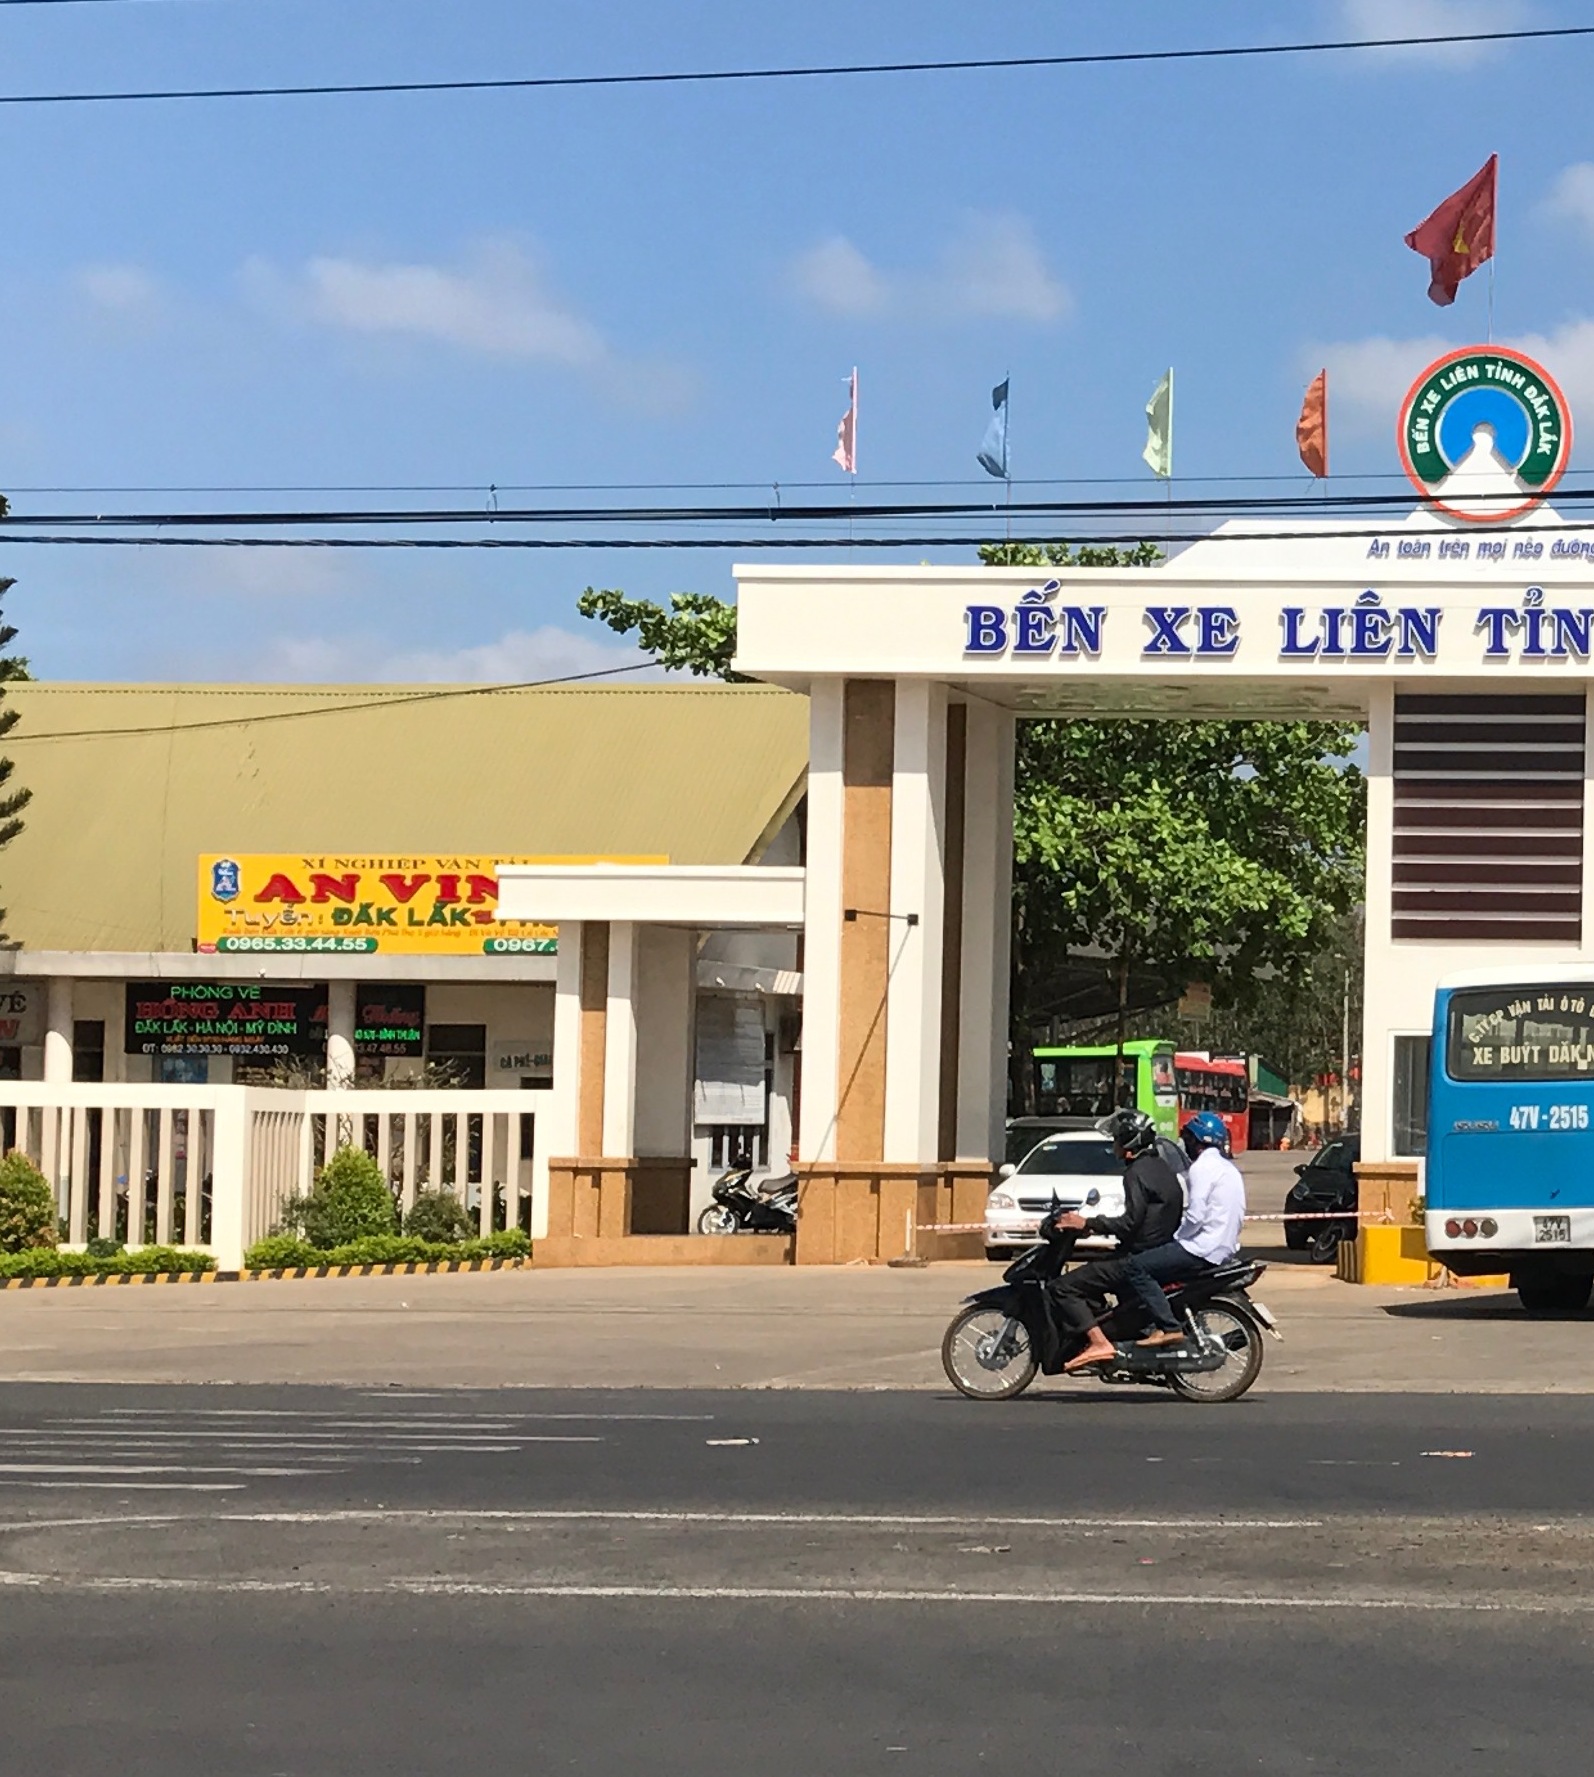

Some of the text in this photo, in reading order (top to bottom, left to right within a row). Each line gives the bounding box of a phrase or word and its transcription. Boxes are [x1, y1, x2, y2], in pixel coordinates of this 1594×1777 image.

[1440, 364, 1479, 391] LIÊN
[1485, 361, 1526, 390] TỈNH
[1420, 389, 1442, 414] XE
[1411, 417, 1430, 454] BẾN
[1367, 538, 1390, 557] An
[1397, 538, 1431, 557] toàn
[1438, 538, 1471, 557] trên
[1477, 538, 1508, 561] mọi
[963, 578, 1107, 655] BẾN
[1142, 604, 1242, 655] XE
[1279, 588, 1443, 656] LIÊN
[302, 857, 325, 870] XÍ
[254, 873, 361, 904] AN
[226, 937, 368, 951] 0965.33.44.55
[493, 938, 559, 952] 0967.
[228, 1002, 296, 1020] ANH
[1472, 1047, 1493, 1065] XE
[1539, 1229, 1566, 1242] 2515
